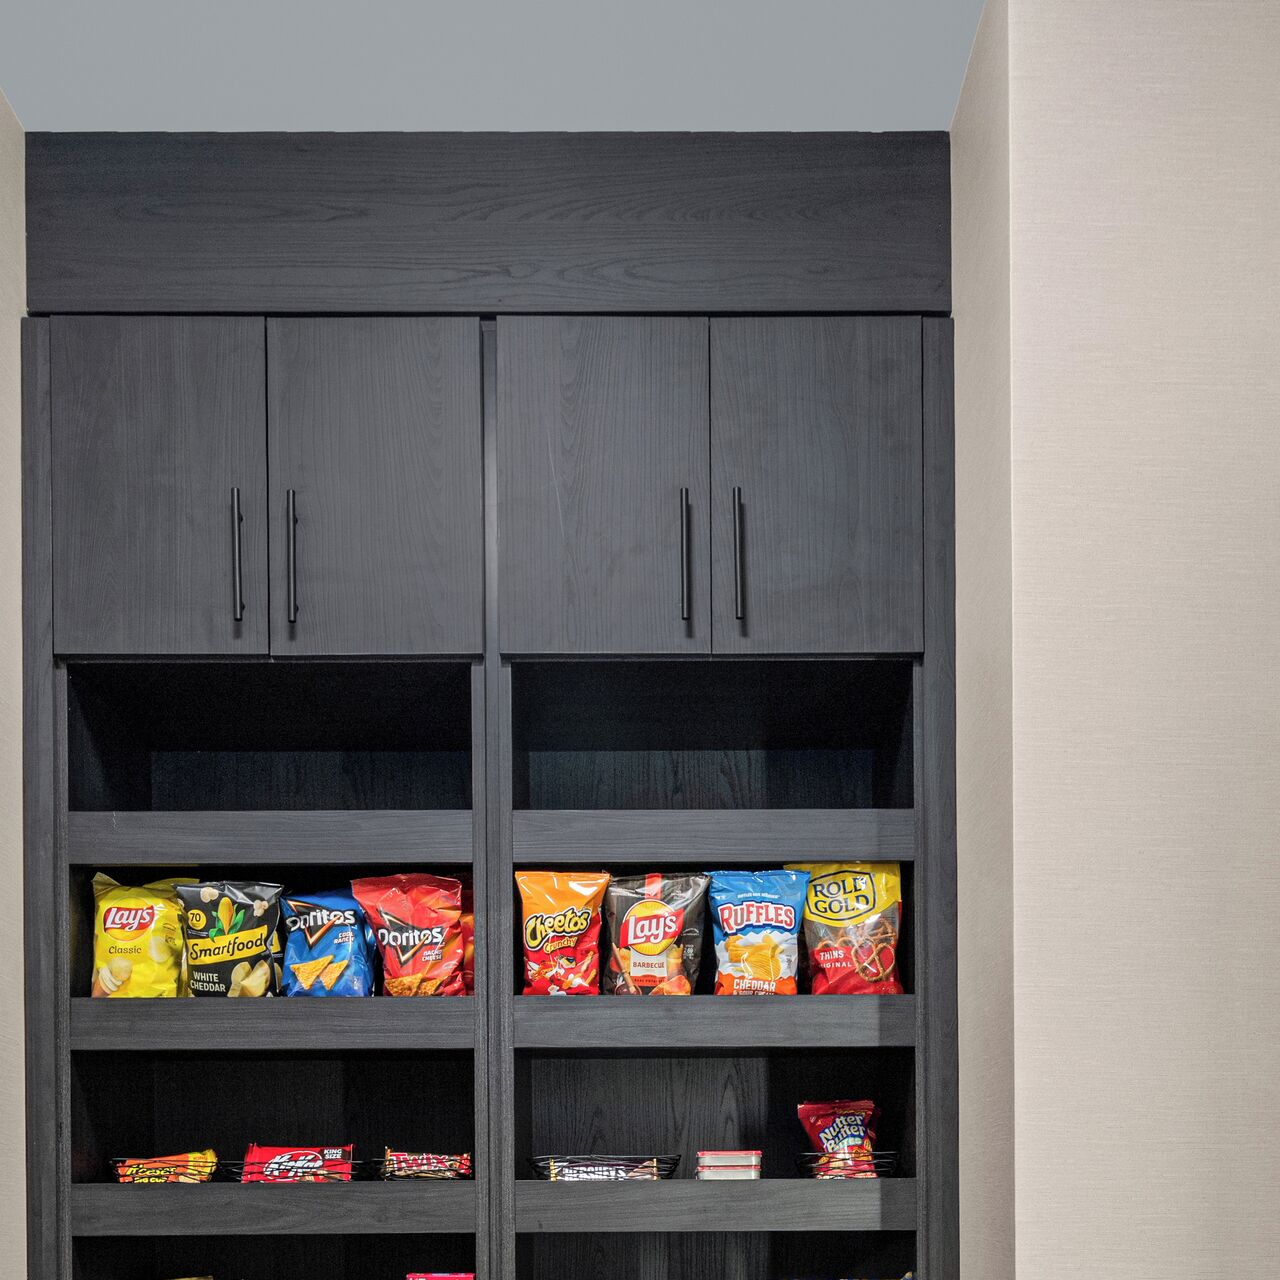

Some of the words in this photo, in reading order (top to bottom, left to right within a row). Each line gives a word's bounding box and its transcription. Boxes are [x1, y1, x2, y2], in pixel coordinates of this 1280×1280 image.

[813, 876, 867, 898] ROLD
[814, 896, 869, 915] GOLD
[105, 905, 154, 931] Lay's
[190, 913, 201, 923] 70
[286, 910, 356, 931] Doritos
[525, 907, 591, 949] Cheetos
[719, 902, 795, 933] RUFFLES
[378, 927, 444, 946] Doritos
[628, 912, 677, 945] Lay's
[108, 945, 142, 955] Classic
[190, 933, 264, 961] Smartfood
[543, 936, 578, 954] Crunchy
[632, 961, 665, 969] BARBECUE
[190, 979, 226, 993] CHEDDAR
[192, 971, 219, 983] WHITE
[819, 1113, 864, 1143] Nutter
[826, 1123, 866, 1151] Butter
